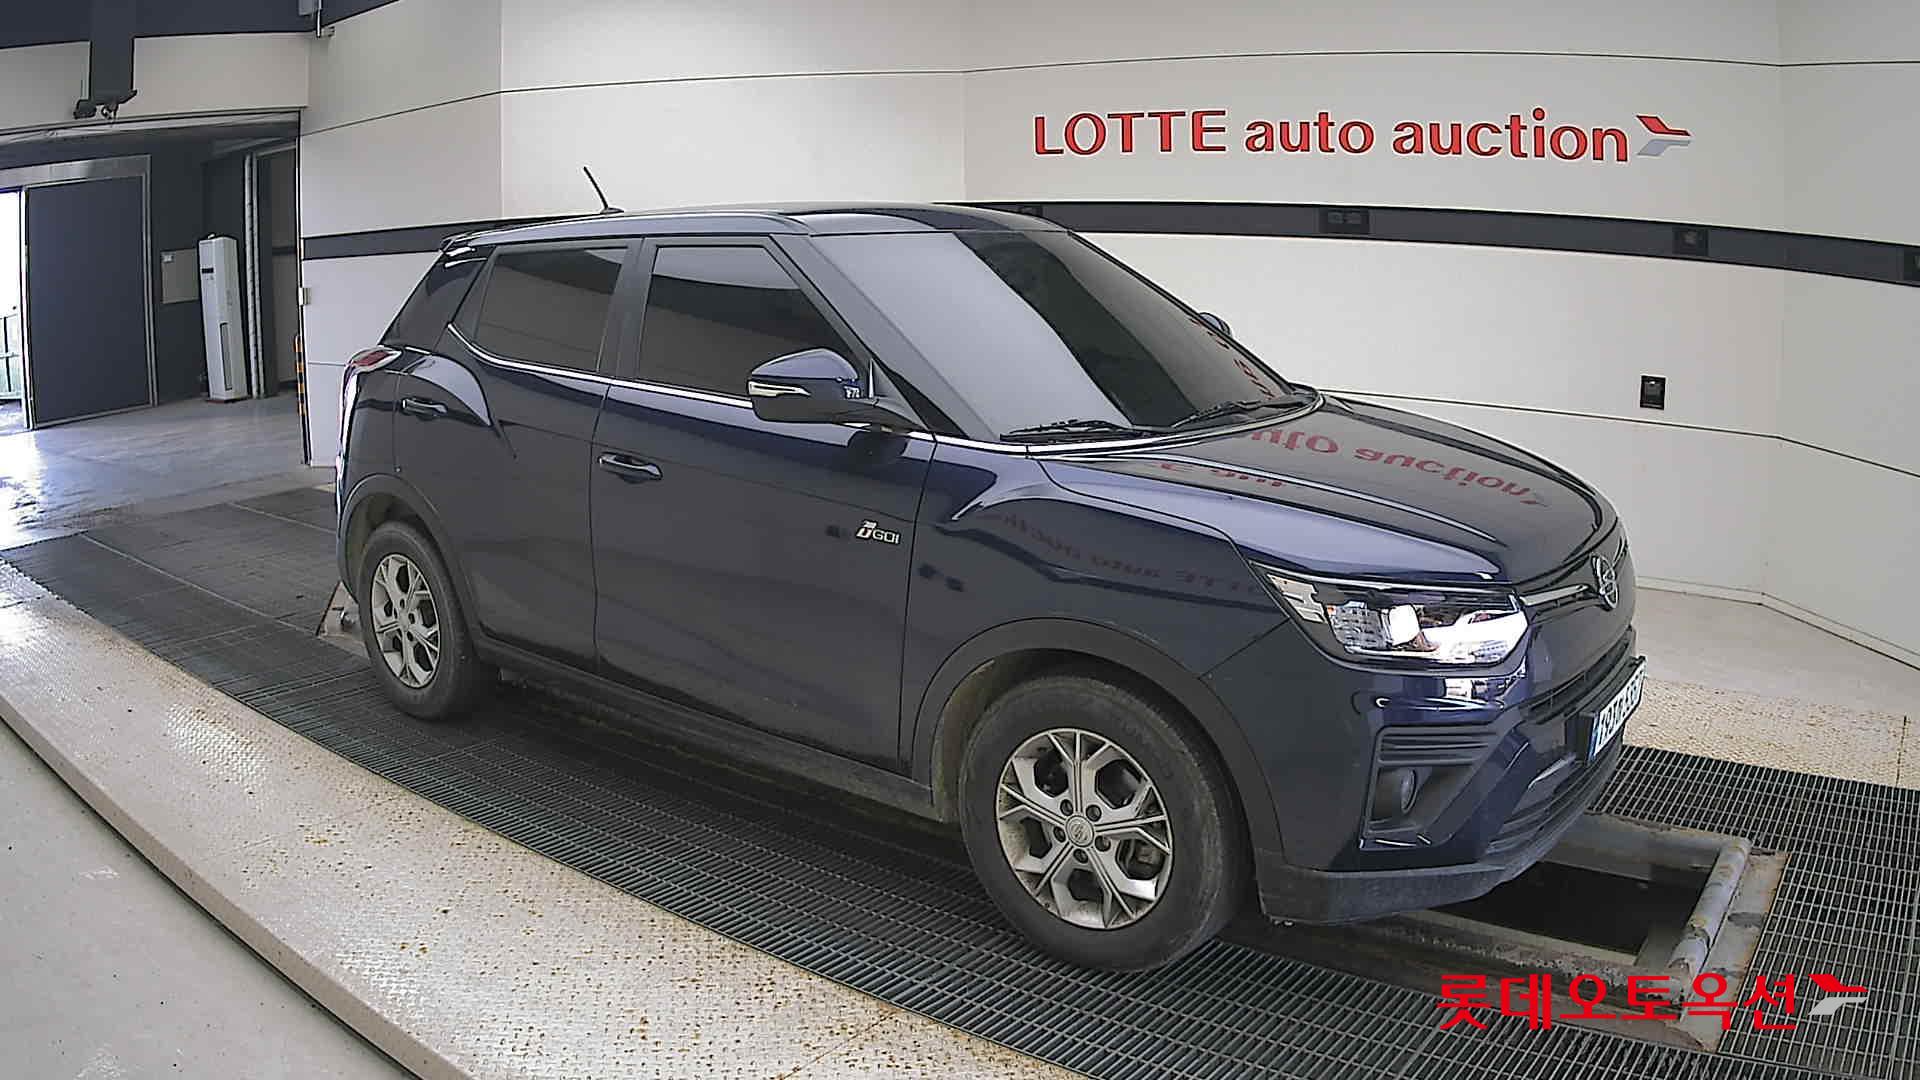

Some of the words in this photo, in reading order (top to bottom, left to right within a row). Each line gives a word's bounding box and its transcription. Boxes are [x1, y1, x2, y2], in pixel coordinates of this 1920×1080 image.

[1034, 110, 1227, 155] LOTTE
[1245, 111, 1375, 155] auto
[1392, 107, 1628, 162] auction
